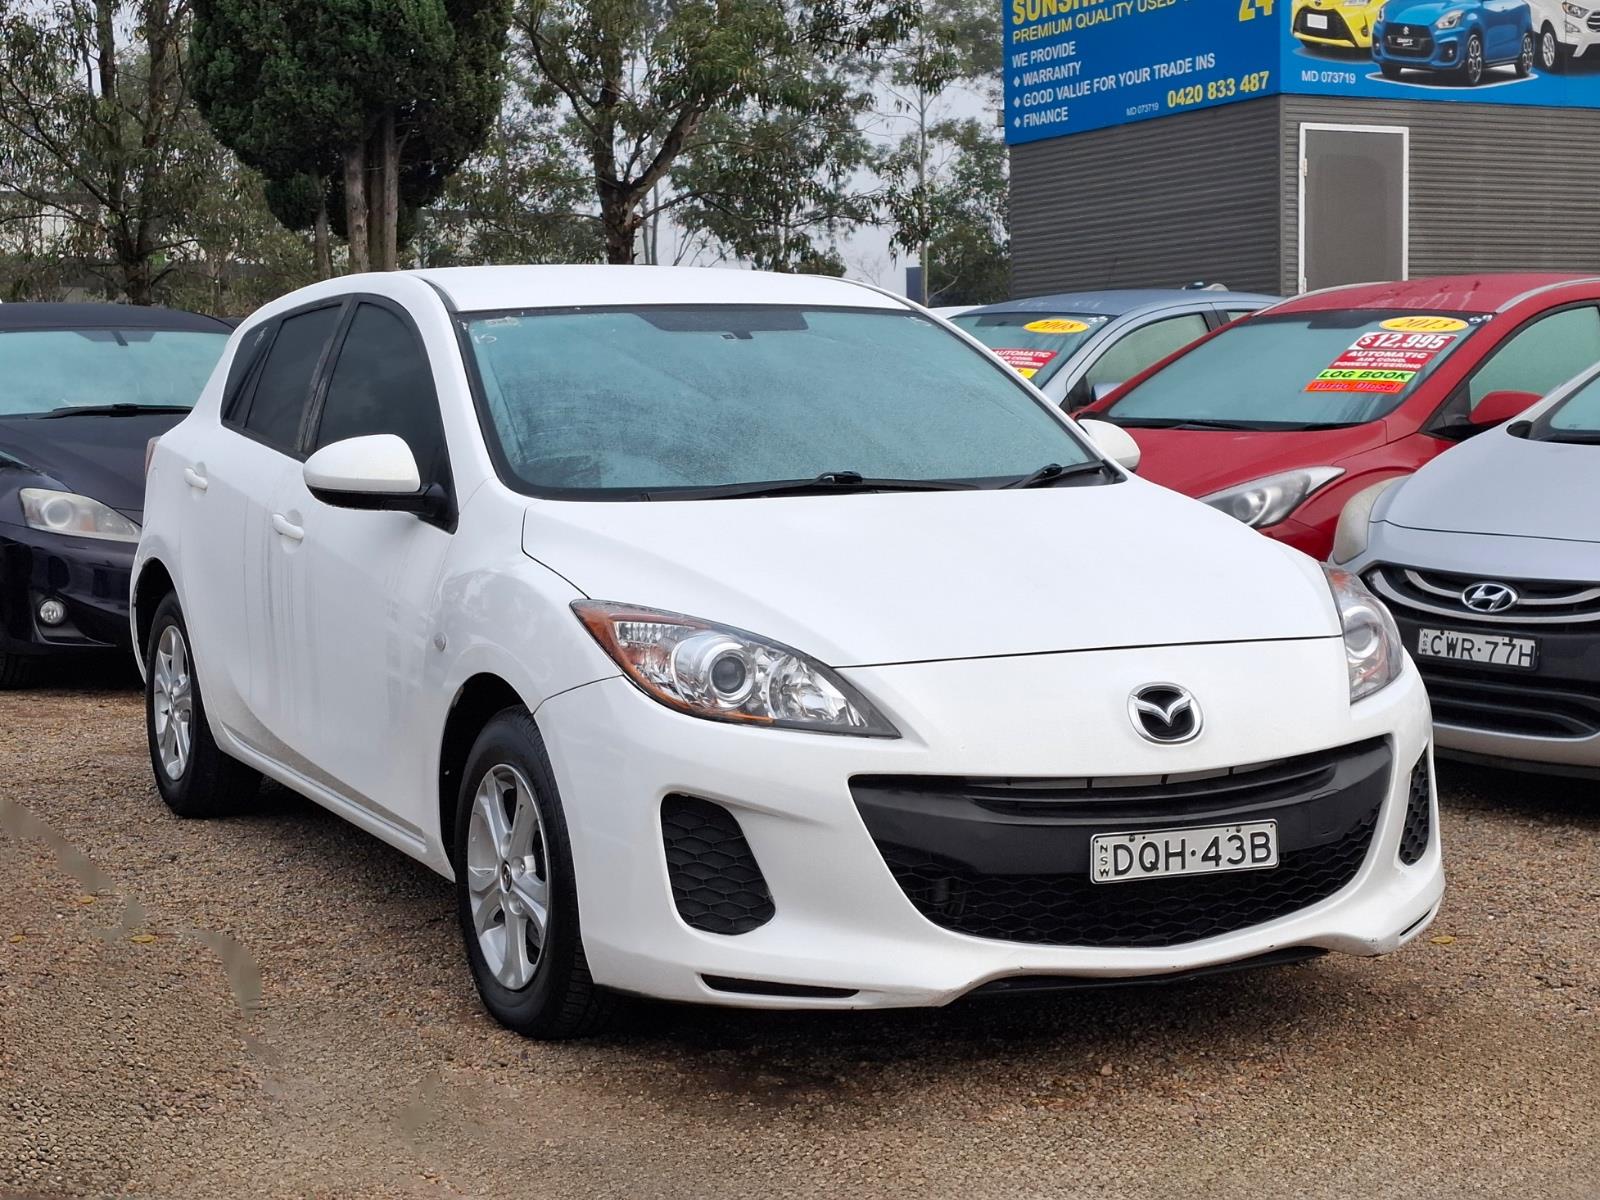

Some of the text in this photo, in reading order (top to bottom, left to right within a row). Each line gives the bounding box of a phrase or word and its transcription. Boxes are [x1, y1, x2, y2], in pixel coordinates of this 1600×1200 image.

[1013, 17, 1072, 44] PREMIUM
[1075, 1, 1134, 29] QUALITY
[1012, 41, 1076, 68] WE PROVIDE
[1023, 61, 1081, 86] WARRANTY
[1023, 53, 1216, 107] GOOD VALUE FOR YOUR TRADE INS
[1301, 70, 1356, 84] MD 073719
[1167, 70, 1270, 108] 0420 833 487
[1023, 106, 1069, 128] FINANCE
[1126, 106, 1137, 116] MD
[1360, 333, 1450, 349] $12,995
[1346, 351, 1428, 359] AUTOMATIC
[1319, 370, 1412, 380] LOG BOOK
